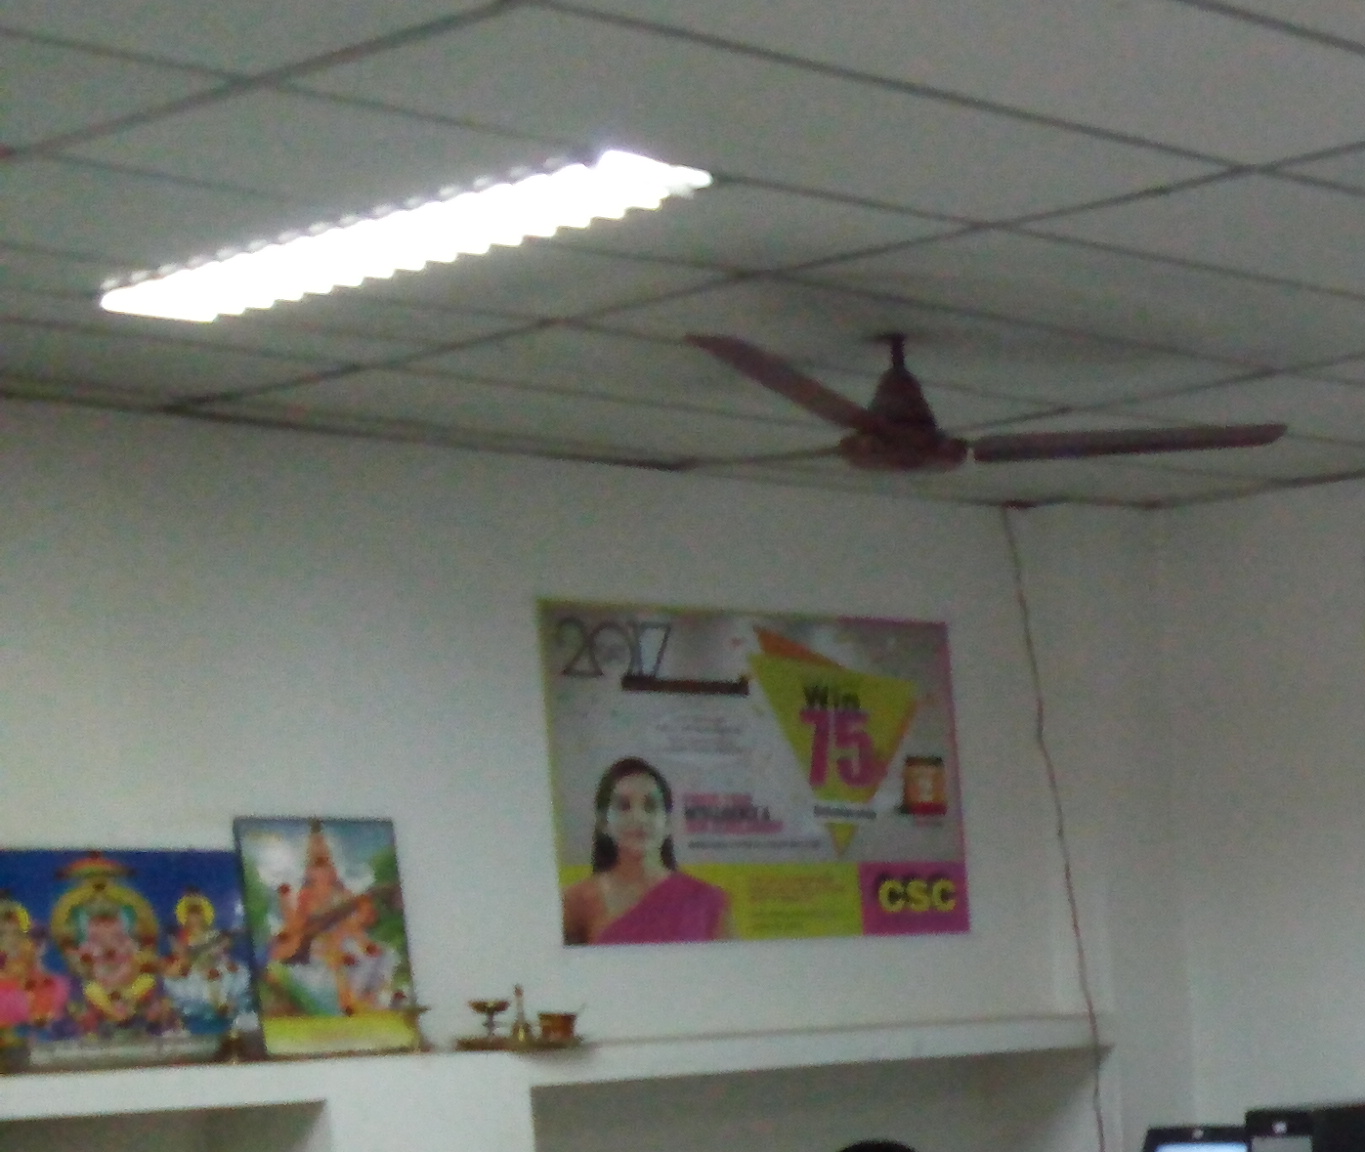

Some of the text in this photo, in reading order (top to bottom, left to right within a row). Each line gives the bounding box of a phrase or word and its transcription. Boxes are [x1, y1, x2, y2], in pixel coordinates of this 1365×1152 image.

[556, 617, 672, 677] 2017
[803, 686, 861, 710] Win
[800, 710, 878, 788] 75
[877, 877, 957, 912] CSC
